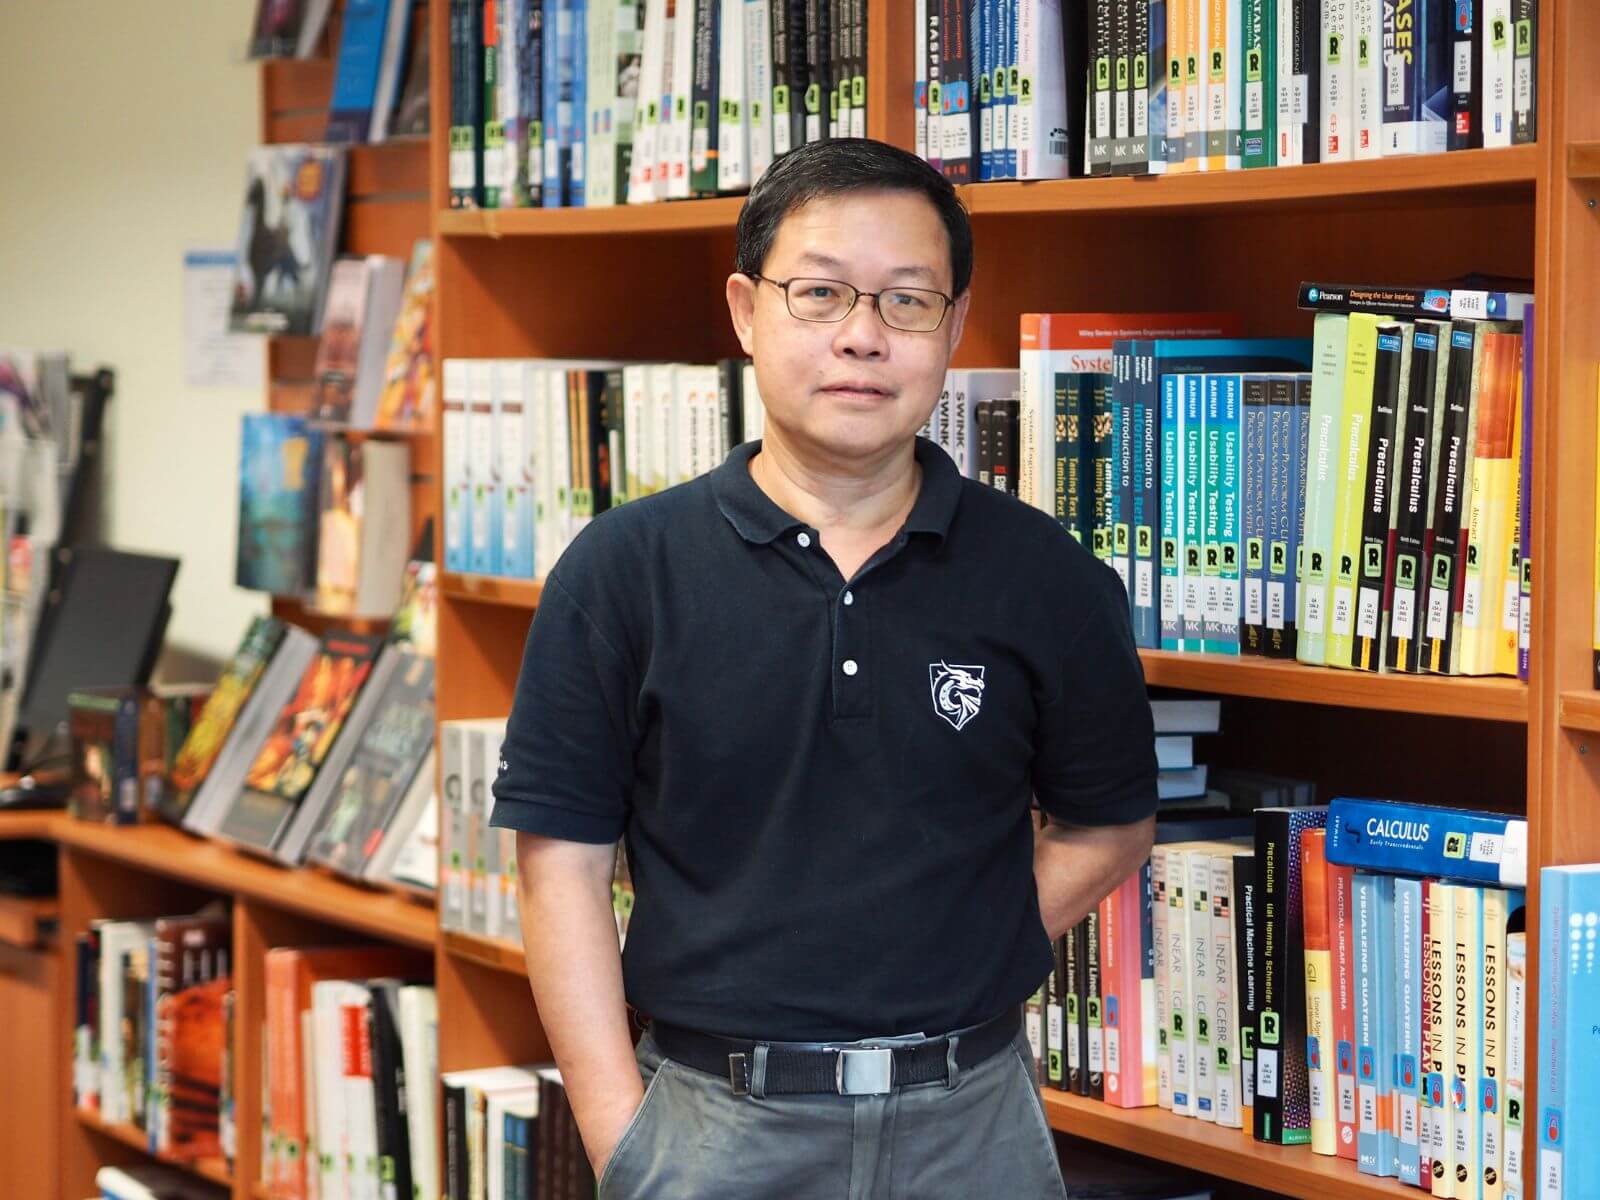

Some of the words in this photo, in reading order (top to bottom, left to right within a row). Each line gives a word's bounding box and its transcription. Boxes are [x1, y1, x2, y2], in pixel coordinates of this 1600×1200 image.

[1494, 21, 1503, 40] R
[1094, 143, 1107, 156] MK
[1115, 145, 1126, 157] MK
[1132, 143, 1145, 155] MK
[1320, 291, 1343, 301] Pearson
[1189, 379, 1197, 418] BARNUM
[1210, 379, 1218, 418] BARNUM
[1226, 380, 1234, 419] BARNUM
[956, 391, 965, 447] SWINK
[1122, 406, 1131, 474] Introduction
[1145, 407, 1153, 477] Introduction
[1317, 415, 1332, 481] Precalculus
[1347, 413, 1363, 481] Precalculus
[1163, 431, 1174, 487] Usability
[1187, 430, 1198, 487] Usability
[1208, 430, 1219, 487] Usability
[1224, 431, 1235, 488] Usability
[1068, 457, 1078, 494] Taming
[1122, 475, 1131, 487] to
[1145, 477, 1153, 489] to
[1373, 437, 1389, 513] Precalculus
[1408, 436, 1425, 513] Precalculus
[1444, 435, 1461, 513] Precalculus
[1069, 496, 1077, 517] Text
[1163, 490, 1174, 536] Testing
[1187, 489, 1198, 536] Testing
[1207, 490, 1219, 536] Testing
[1223, 492, 1235, 538] Testing
[1117, 528, 1126, 545] R
[1139, 530, 1148, 547] R
[1164, 541, 1174, 559] R
[1188, 549, 1198, 567] R
[1207, 549, 1217, 567] R
[1223, 546, 1235, 564] R
[1250, 542, 1259, 560] R
[1274, 544, 1283, 563] R
[1368, 548, 1379, 567] R
[1468, 545, 1477, 564] R
[1312, 553, 1322, 571] R
[1341, 556, 1352, 574] R
[1401, 559, 1412, 579] R
[1437, 558, 1448, 578] R
[1163, 621, 1176, 632] MK
[1185, 621, 1199, 631] MK
[1205, 621, 1220, 632] MK
[1221, 624, 1237, 634] MK
[1366, 817, 1430, 843] CALCULUS
[1447, 836, 1459, 854] R
[1266, 842, 1275, 893] Precalculus
[1245, 885, 1254, 925] Practical
[1337, 877, 1345, 929] PRACTICAL
[1087, 912, 1098, 964] Practical
[1360, 886, 1369, 974] VISUALIZING
[1402, 891, 1411, 978] VISUALIZING
[1245, 927, 1255, 967] Machine
[1338, 930, 1346, 966] LINEAR
[1265, 960, 1274, 1003] Schneider
[1338, 966, 1347, 1011] ALGEBRA
[1431, 939, 1442, 1025] LESSONS
[1455, 942, 1467, 1028] LESSONS
[1484, 944, 1496, 1031] LESSONS
[1088, 1001, 1098, 1018] R
[1422, 1007, 1431, 1026] IN
[1173, 1014, 1183, 1032] R
[1198, 1019, 1208, 1036] R
[1264, 1016, 1276, 1034] R
[1421, 1030, 1432, 1073] PLAY
[1432, 1033, 1442, 1052] IN
[1455, 1036, 1466, 1056] IN
[1485, 1039, 1496, 1058] IN
[1218, 1047, 1228, 1065] R
[1509, 1098, 1520, 1121] R
